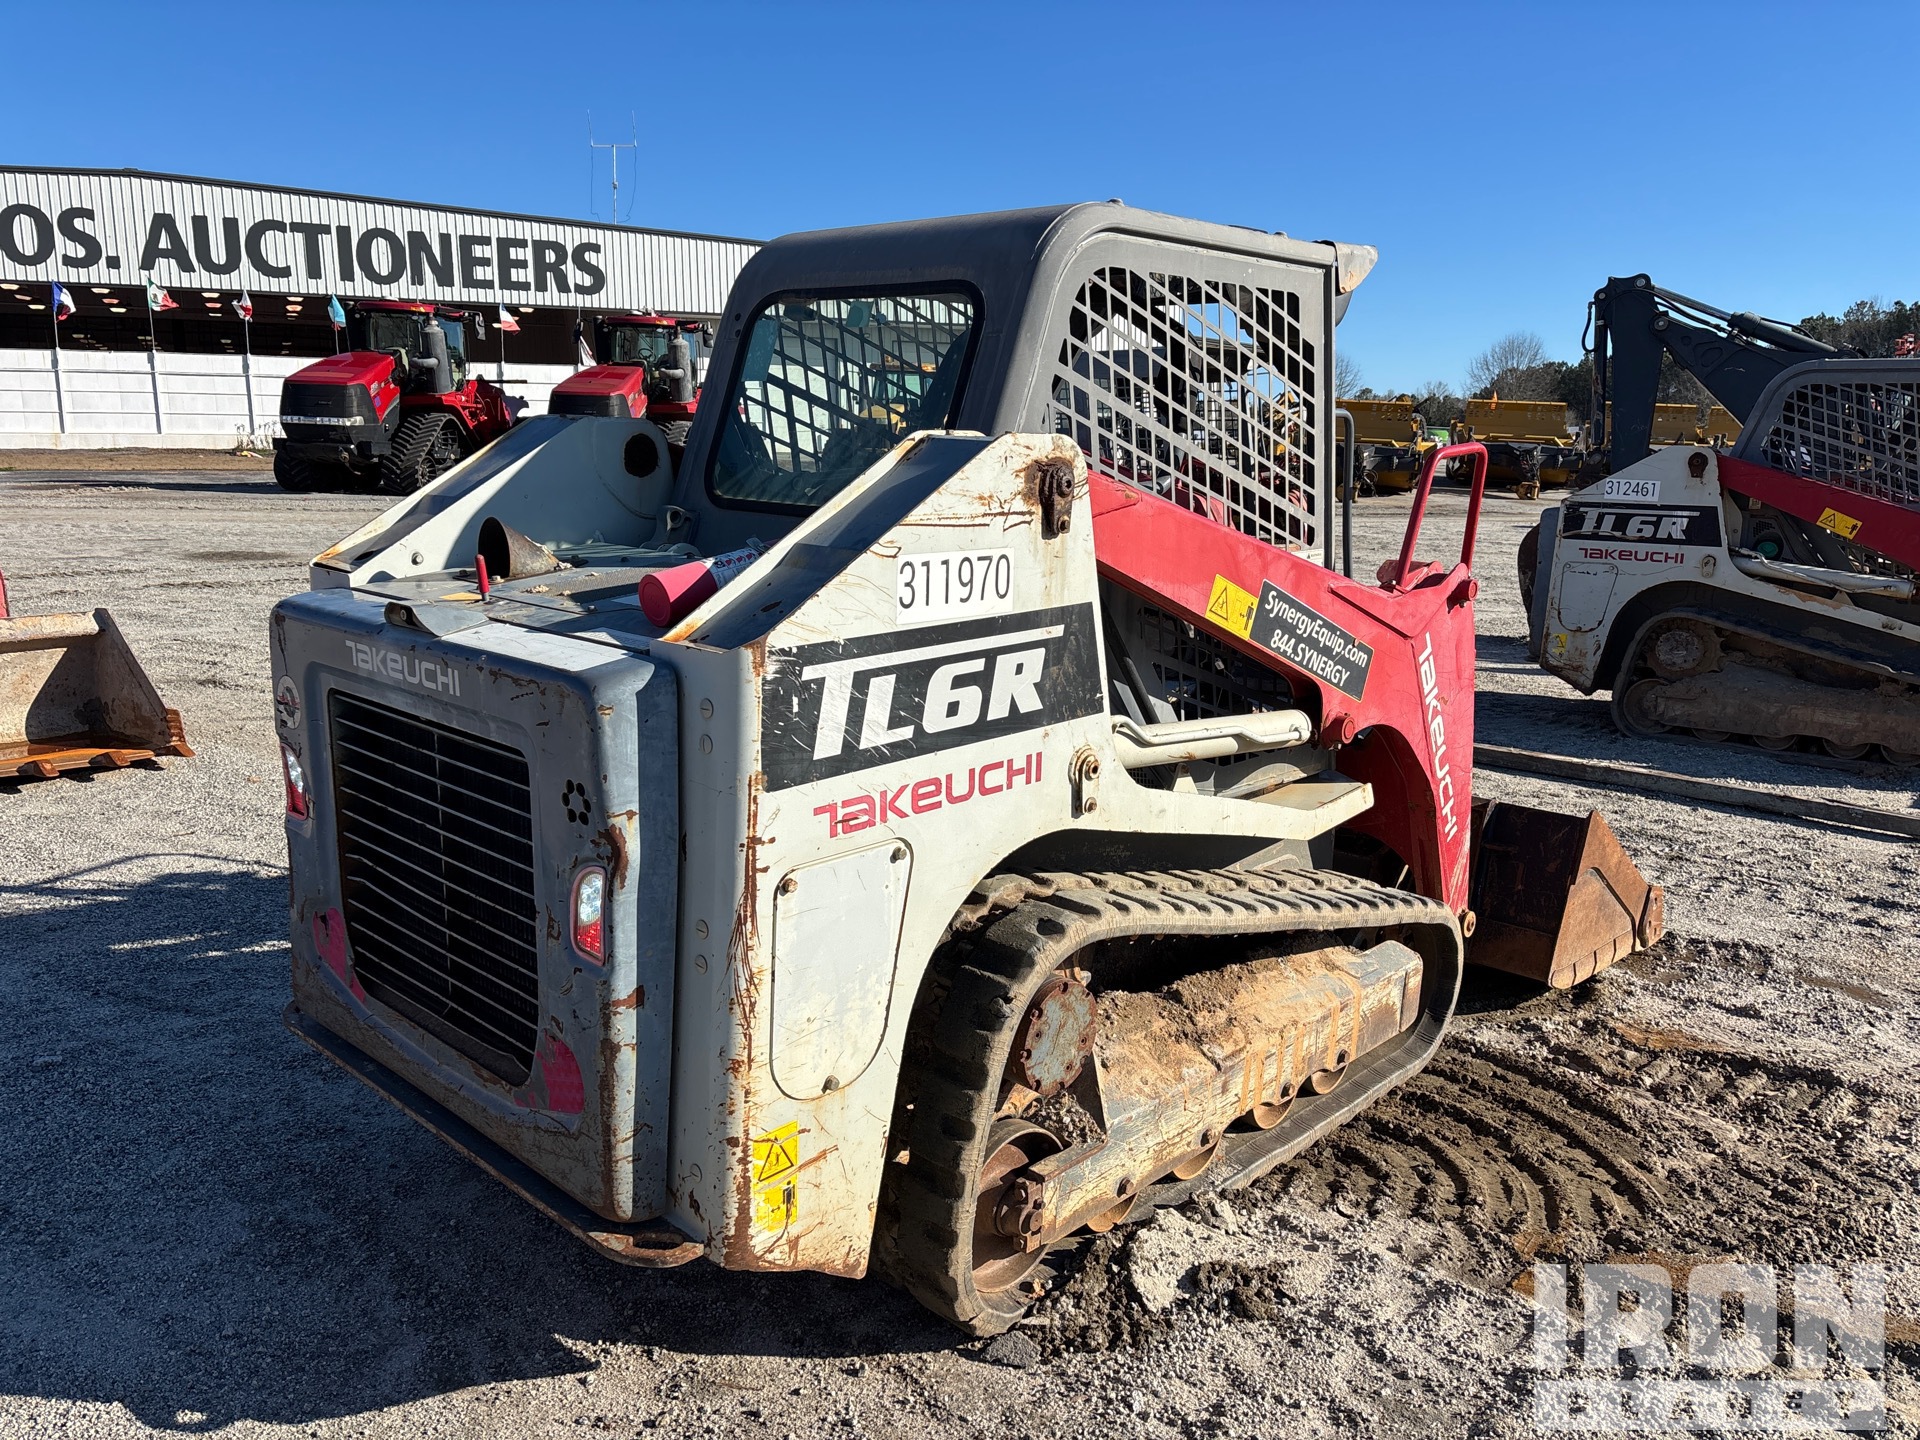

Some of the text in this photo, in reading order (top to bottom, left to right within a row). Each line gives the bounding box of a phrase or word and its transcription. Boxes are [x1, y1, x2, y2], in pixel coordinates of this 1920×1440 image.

[139, 212, 607, 296] AUCTIONEERS
[1605, 480, 1657, 498] 312461
[1579, 506, 1701, 540] TL6R
[899, 553, 1012, 610] 311970
[1264, 590, 1369, 668] SynergyEquip.com
[1270, 629, 1351, 688] 844.SYNERGY
[801, 624, 1065, 761] TL6R
